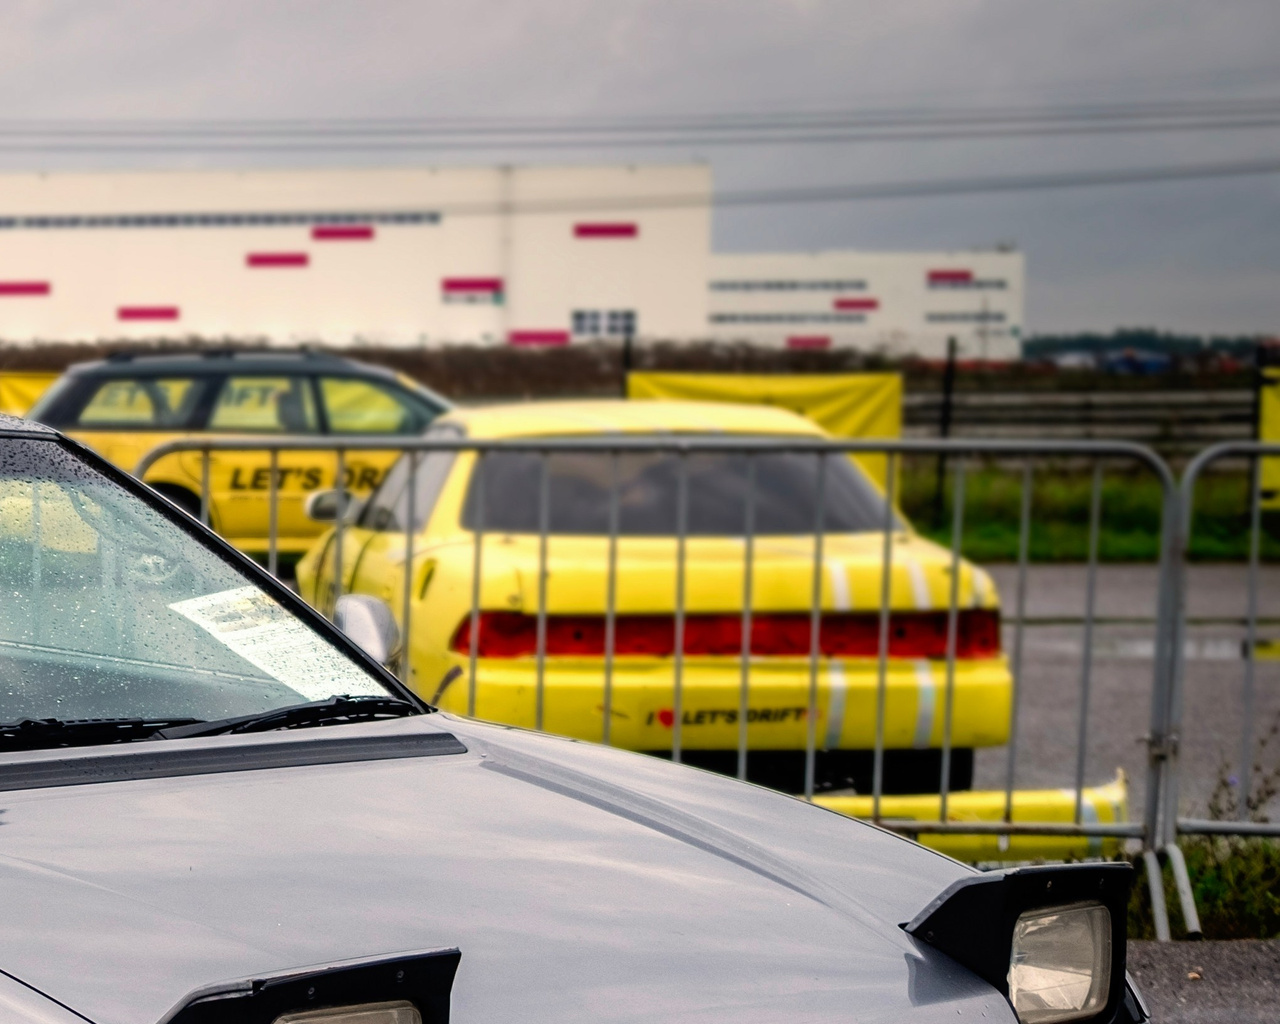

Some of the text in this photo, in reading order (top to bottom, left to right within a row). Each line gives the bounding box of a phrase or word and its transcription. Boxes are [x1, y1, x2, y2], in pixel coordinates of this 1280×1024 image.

[229, 467, 324, 491] LET'S
[682, 709, 739, 725] LET'S
[746, 706, 807, 723] DRIFT
